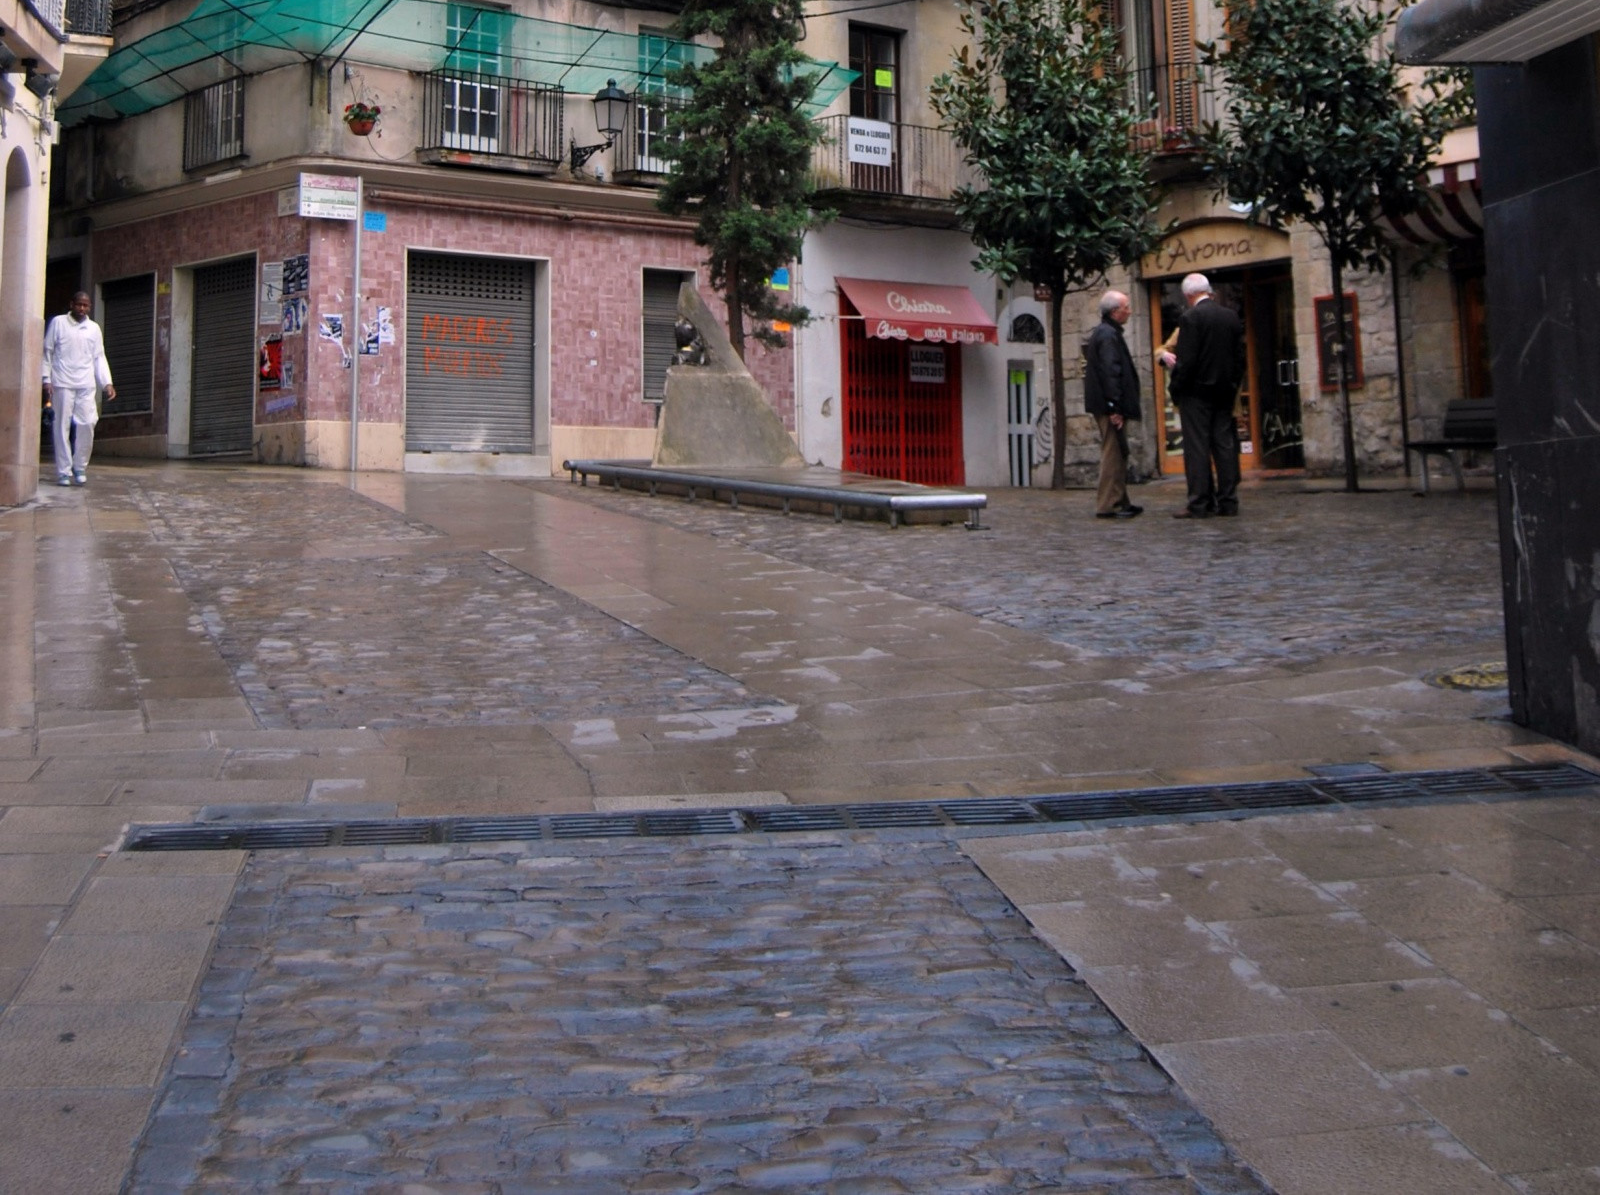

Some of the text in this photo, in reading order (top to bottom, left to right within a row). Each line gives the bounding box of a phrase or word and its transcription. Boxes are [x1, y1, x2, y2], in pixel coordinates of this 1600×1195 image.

[850, 128, 865, 136] VENDA
[870, 130, 890, 139] LLOGUER
[877, 320, 985, 343] Chiara moda italiana
[910, 350, 944, 364] LLOGUER
